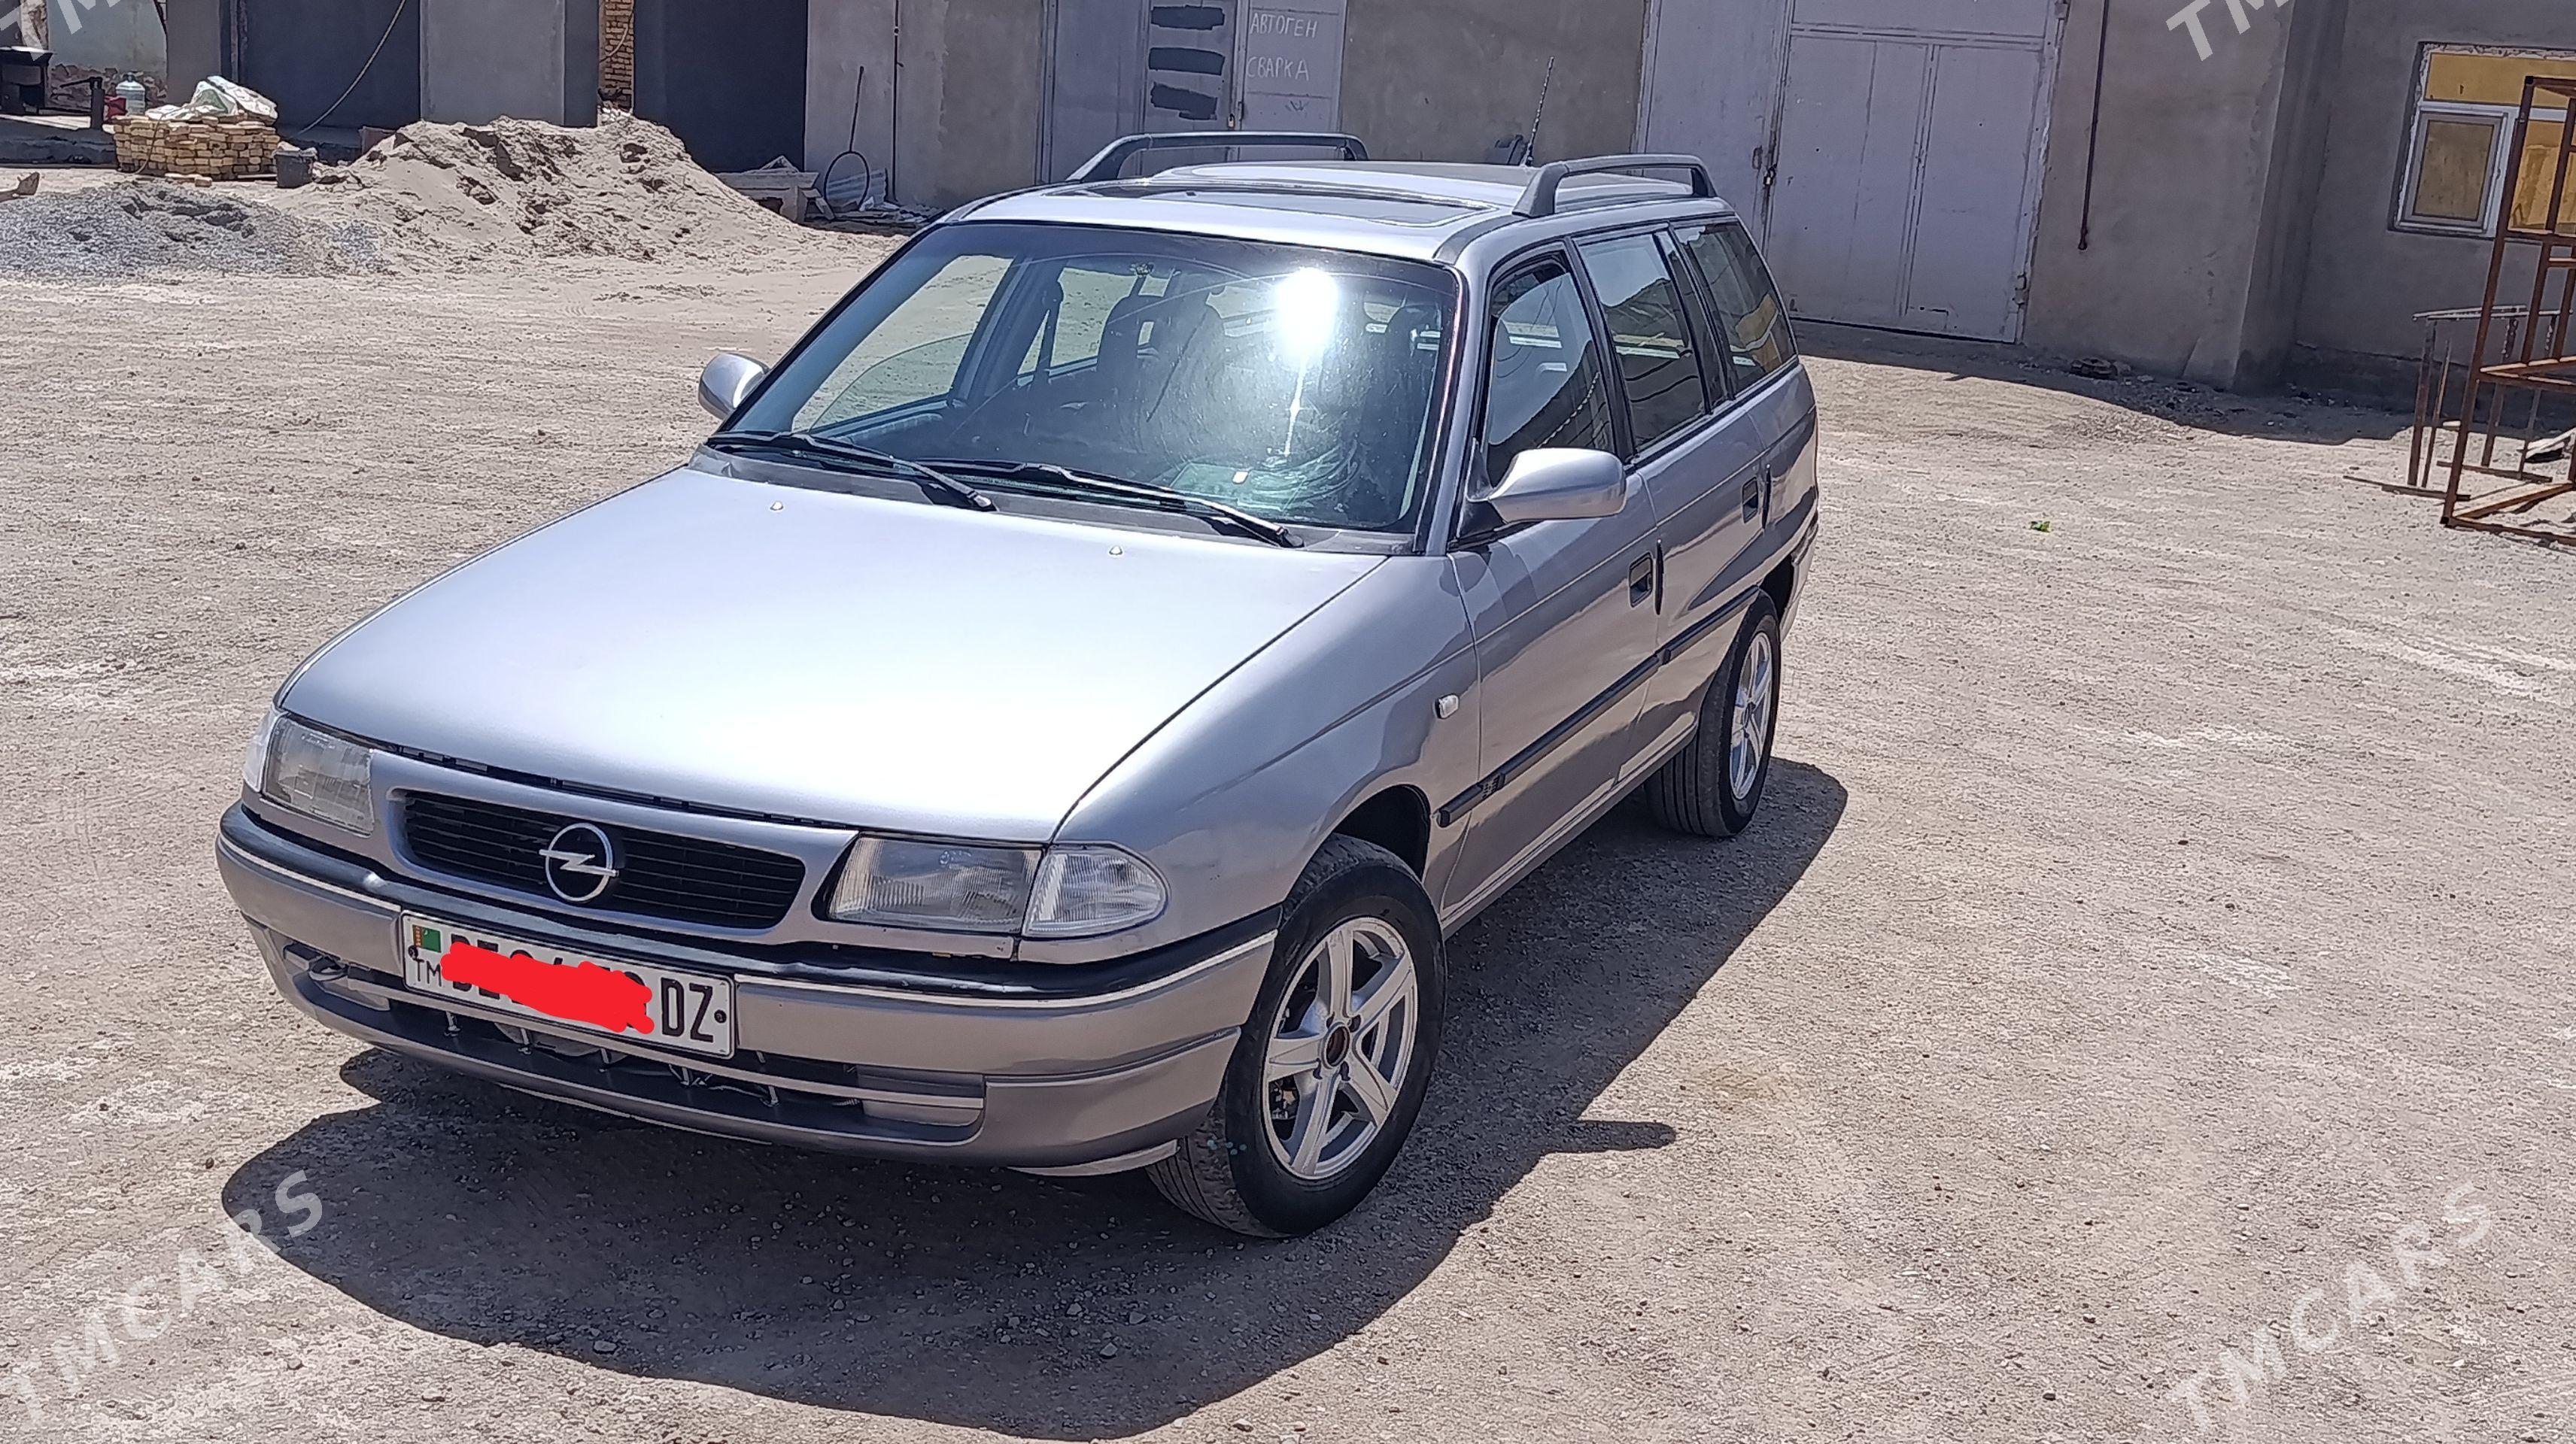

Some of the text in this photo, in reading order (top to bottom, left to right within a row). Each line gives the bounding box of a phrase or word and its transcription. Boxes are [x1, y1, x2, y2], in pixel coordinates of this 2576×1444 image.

[1250, 13, 1317, 38] АВТОГЕН
[1247, 56, 1309, 81] СВАРКА
[415, 957, 443, 987] TM
[661, 977, 714, 1043] DZ
